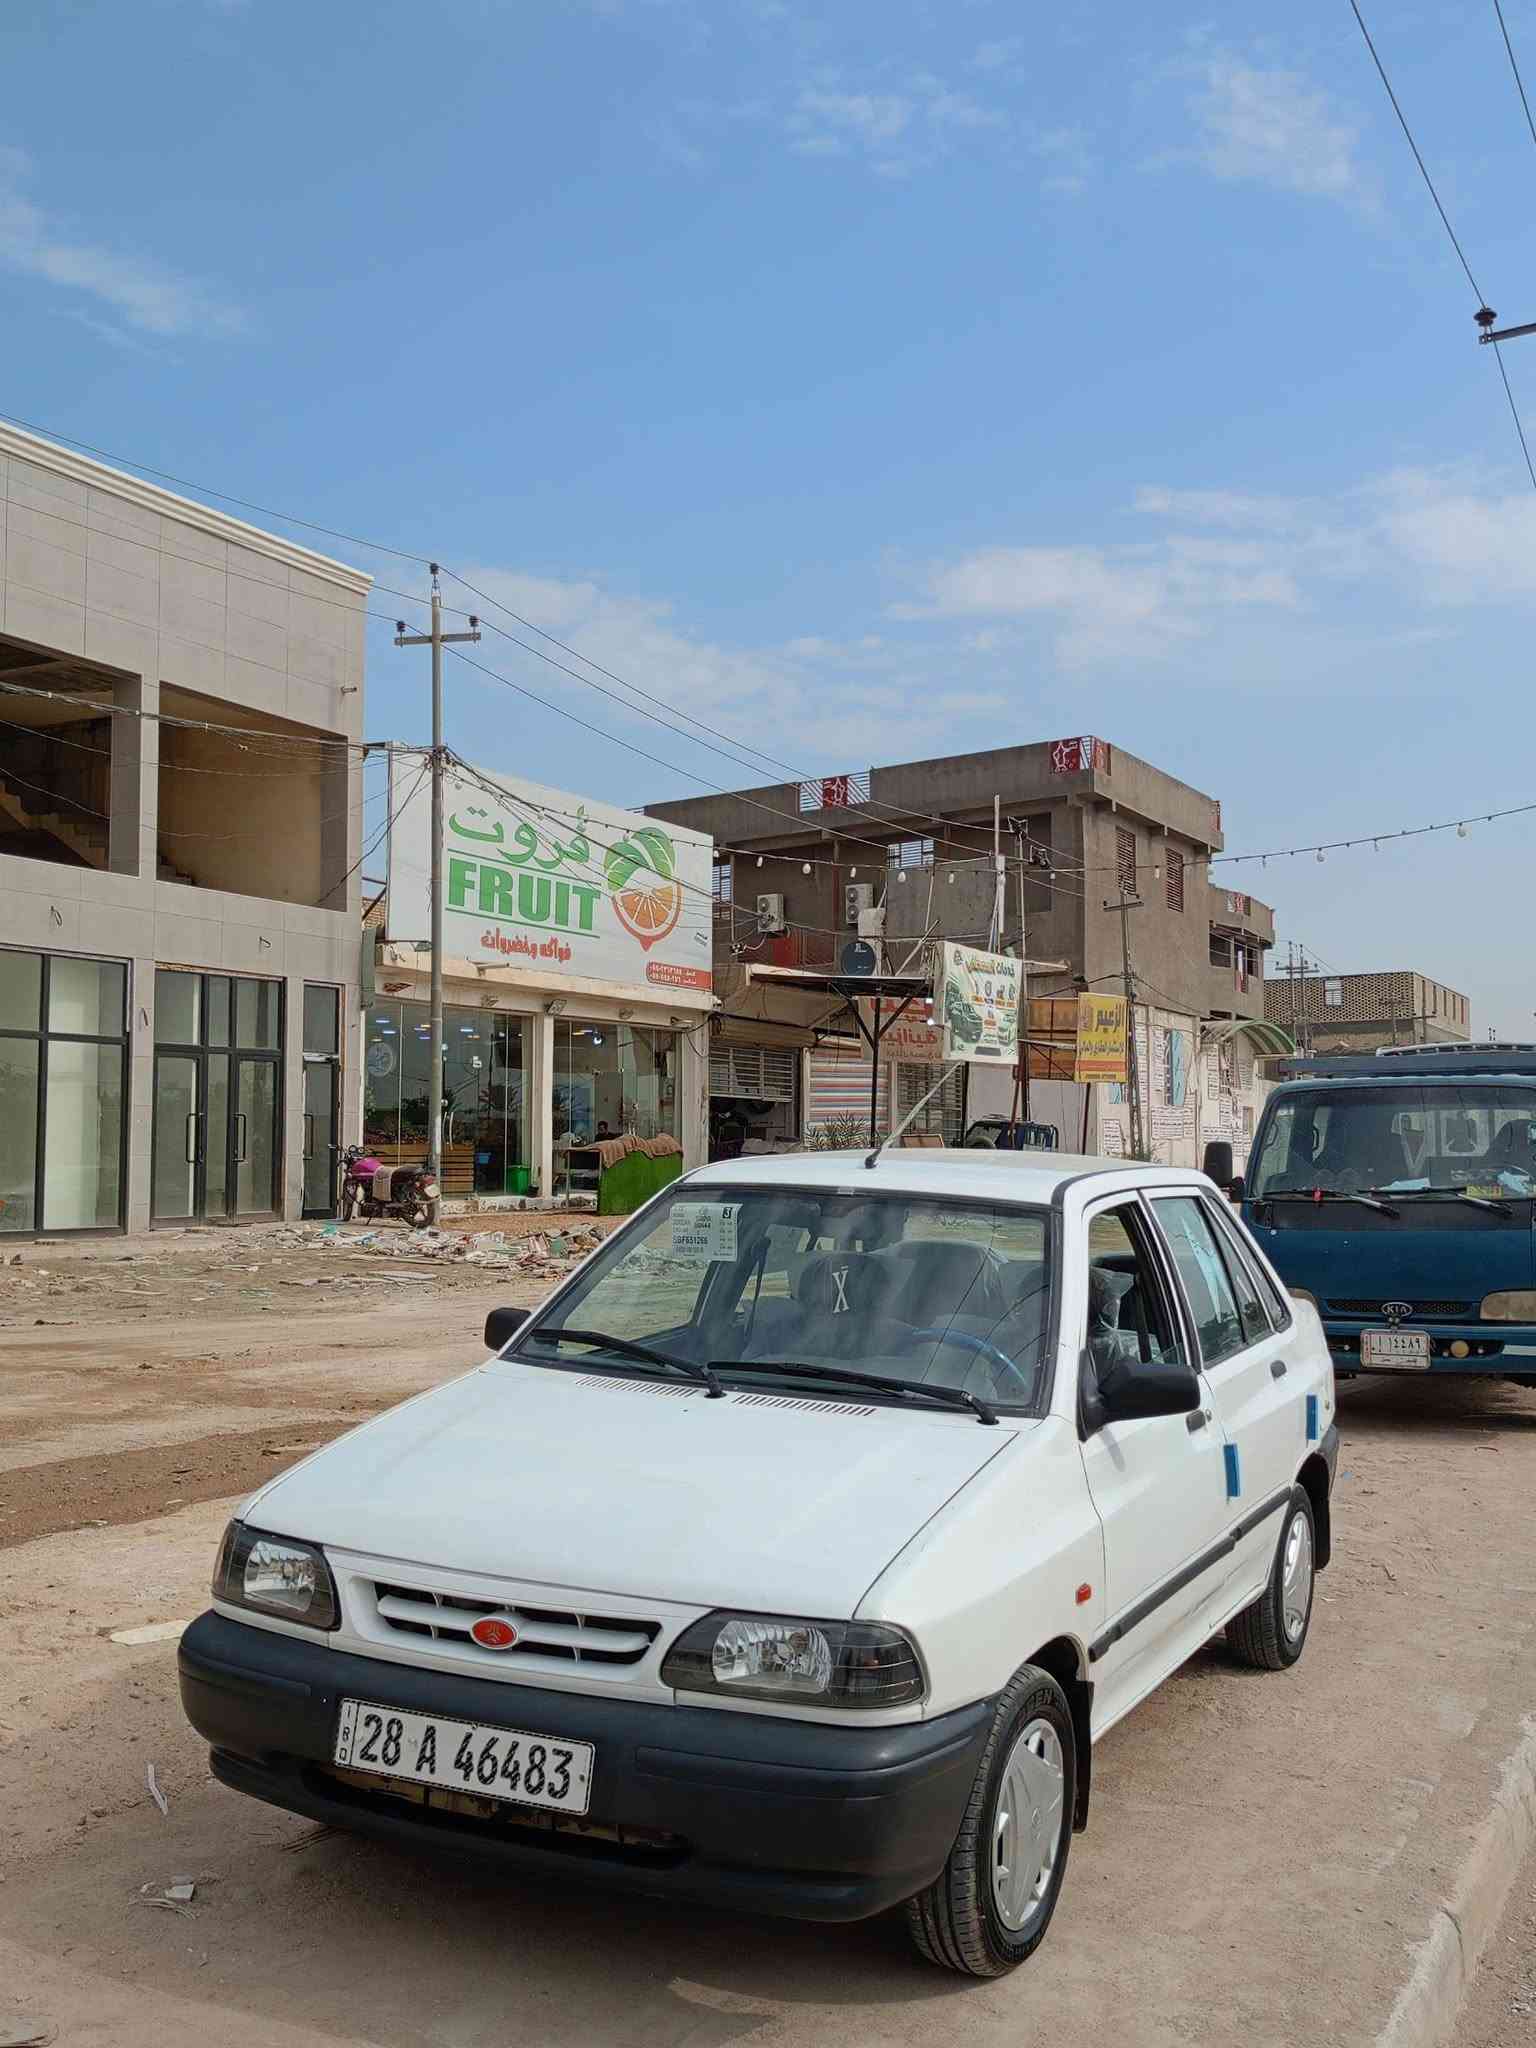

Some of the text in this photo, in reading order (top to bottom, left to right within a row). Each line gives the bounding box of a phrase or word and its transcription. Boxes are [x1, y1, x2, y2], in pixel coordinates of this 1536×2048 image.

[448, 857, 601, 930] FRUIT
[1386, 1305, 1407, 1313] KIA
[359, 1713, 574, 1799] 28 A 46483
